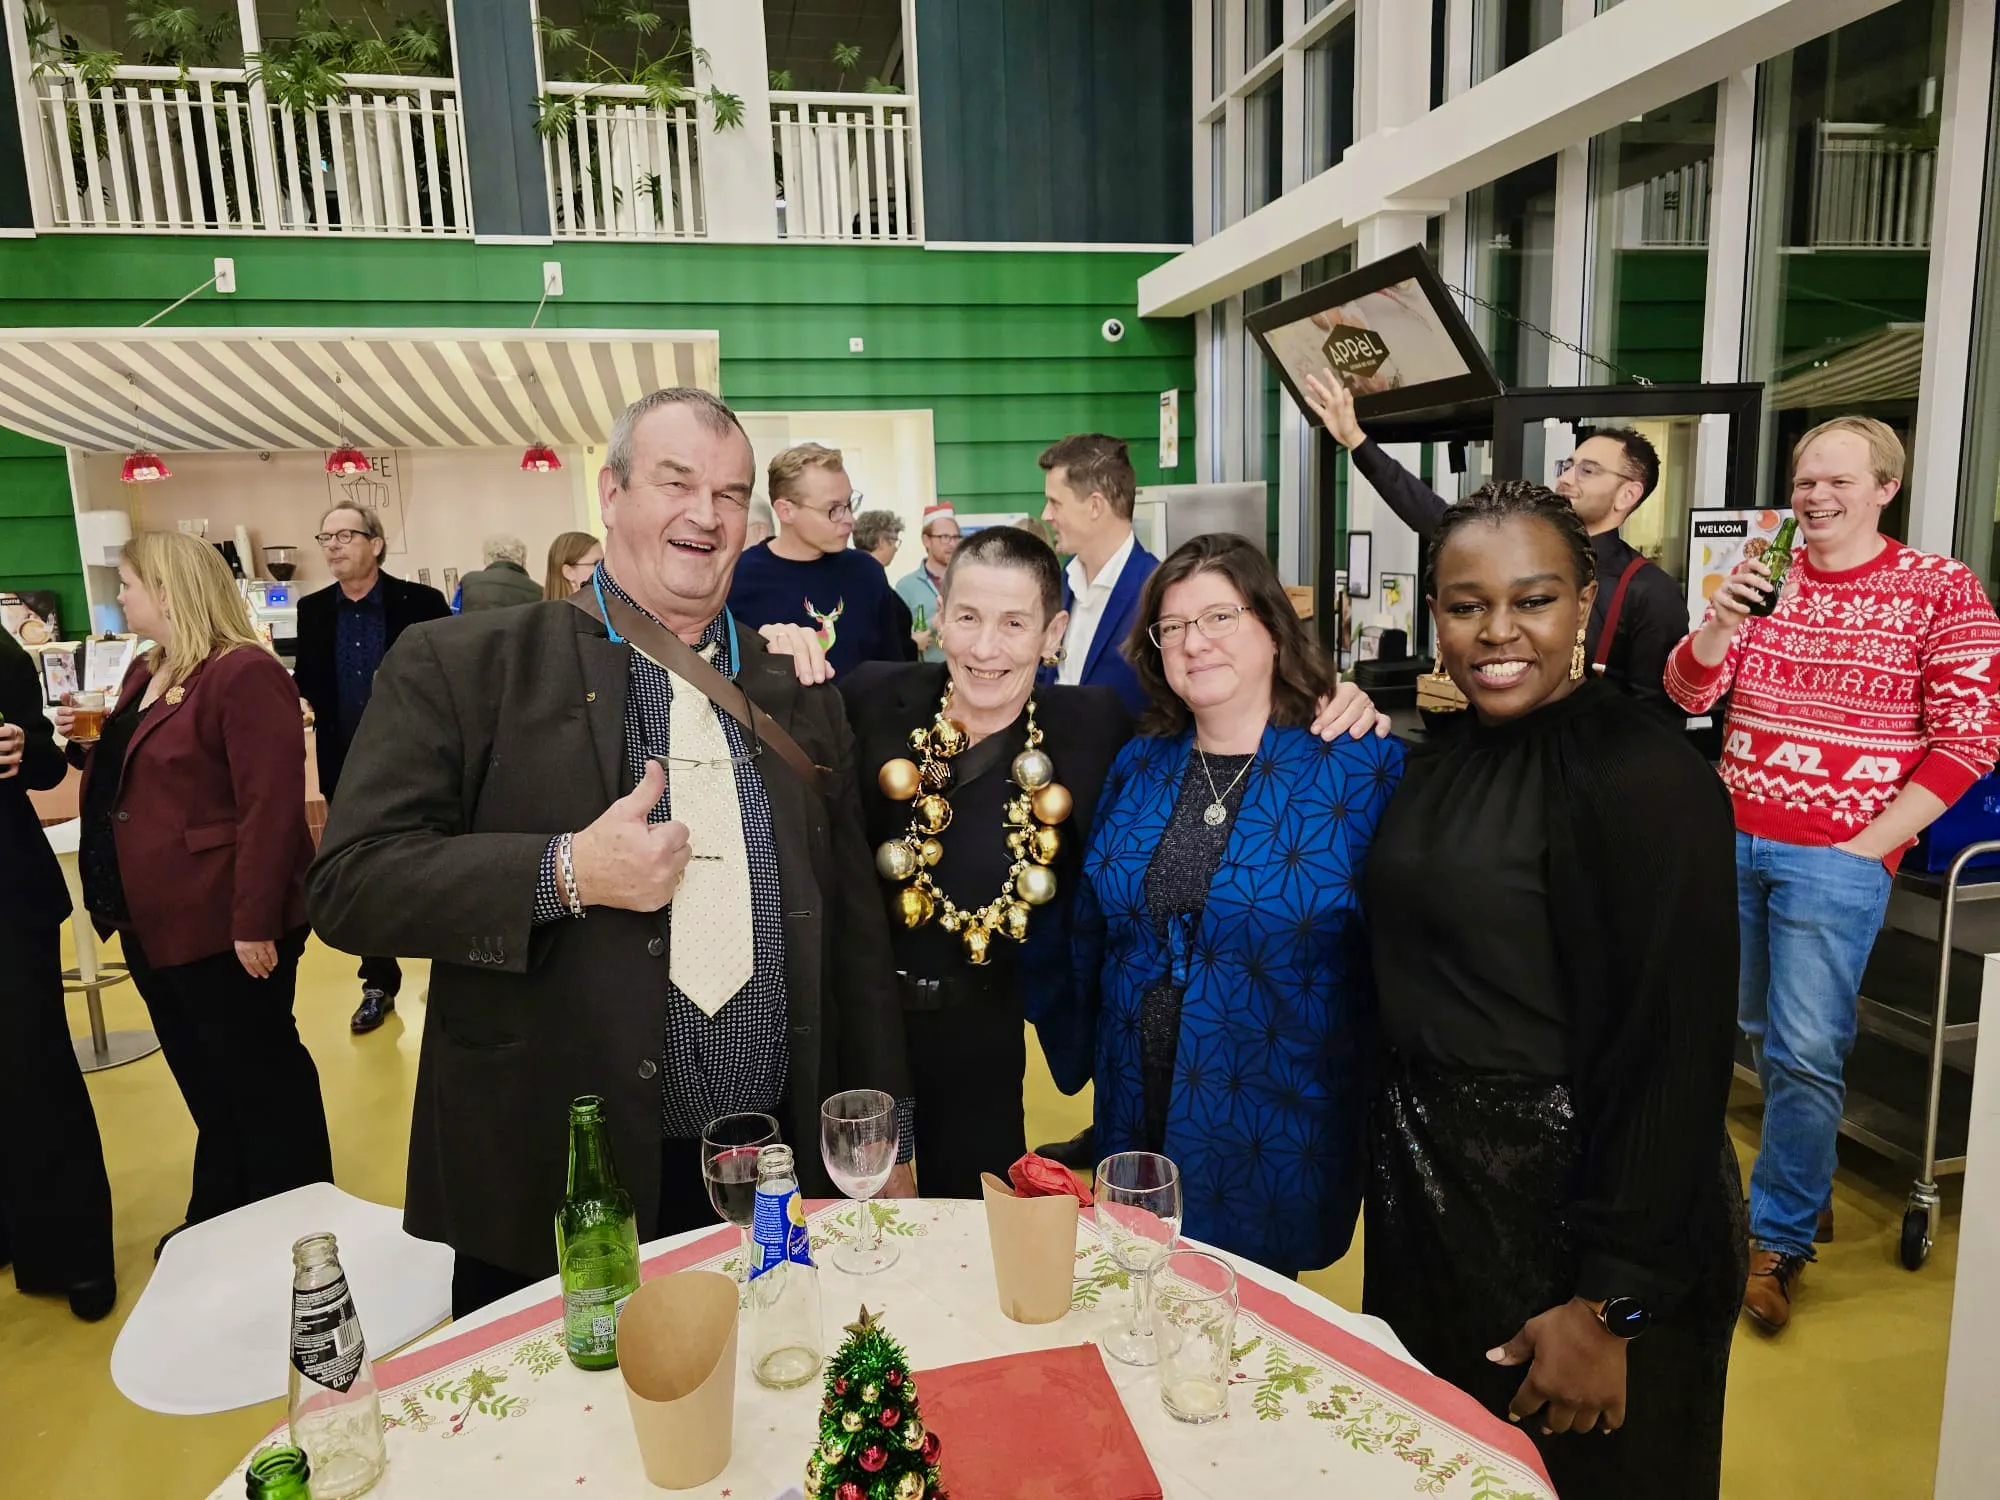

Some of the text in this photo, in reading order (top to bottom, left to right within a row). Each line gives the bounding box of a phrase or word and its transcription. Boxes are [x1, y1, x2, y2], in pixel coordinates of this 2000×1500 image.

[1699, 524, 1742, 534] WELKOM
[1860, 717, 1874, 727] AZ
[1725, 729, 1901, 783] AZ AZ AZ
